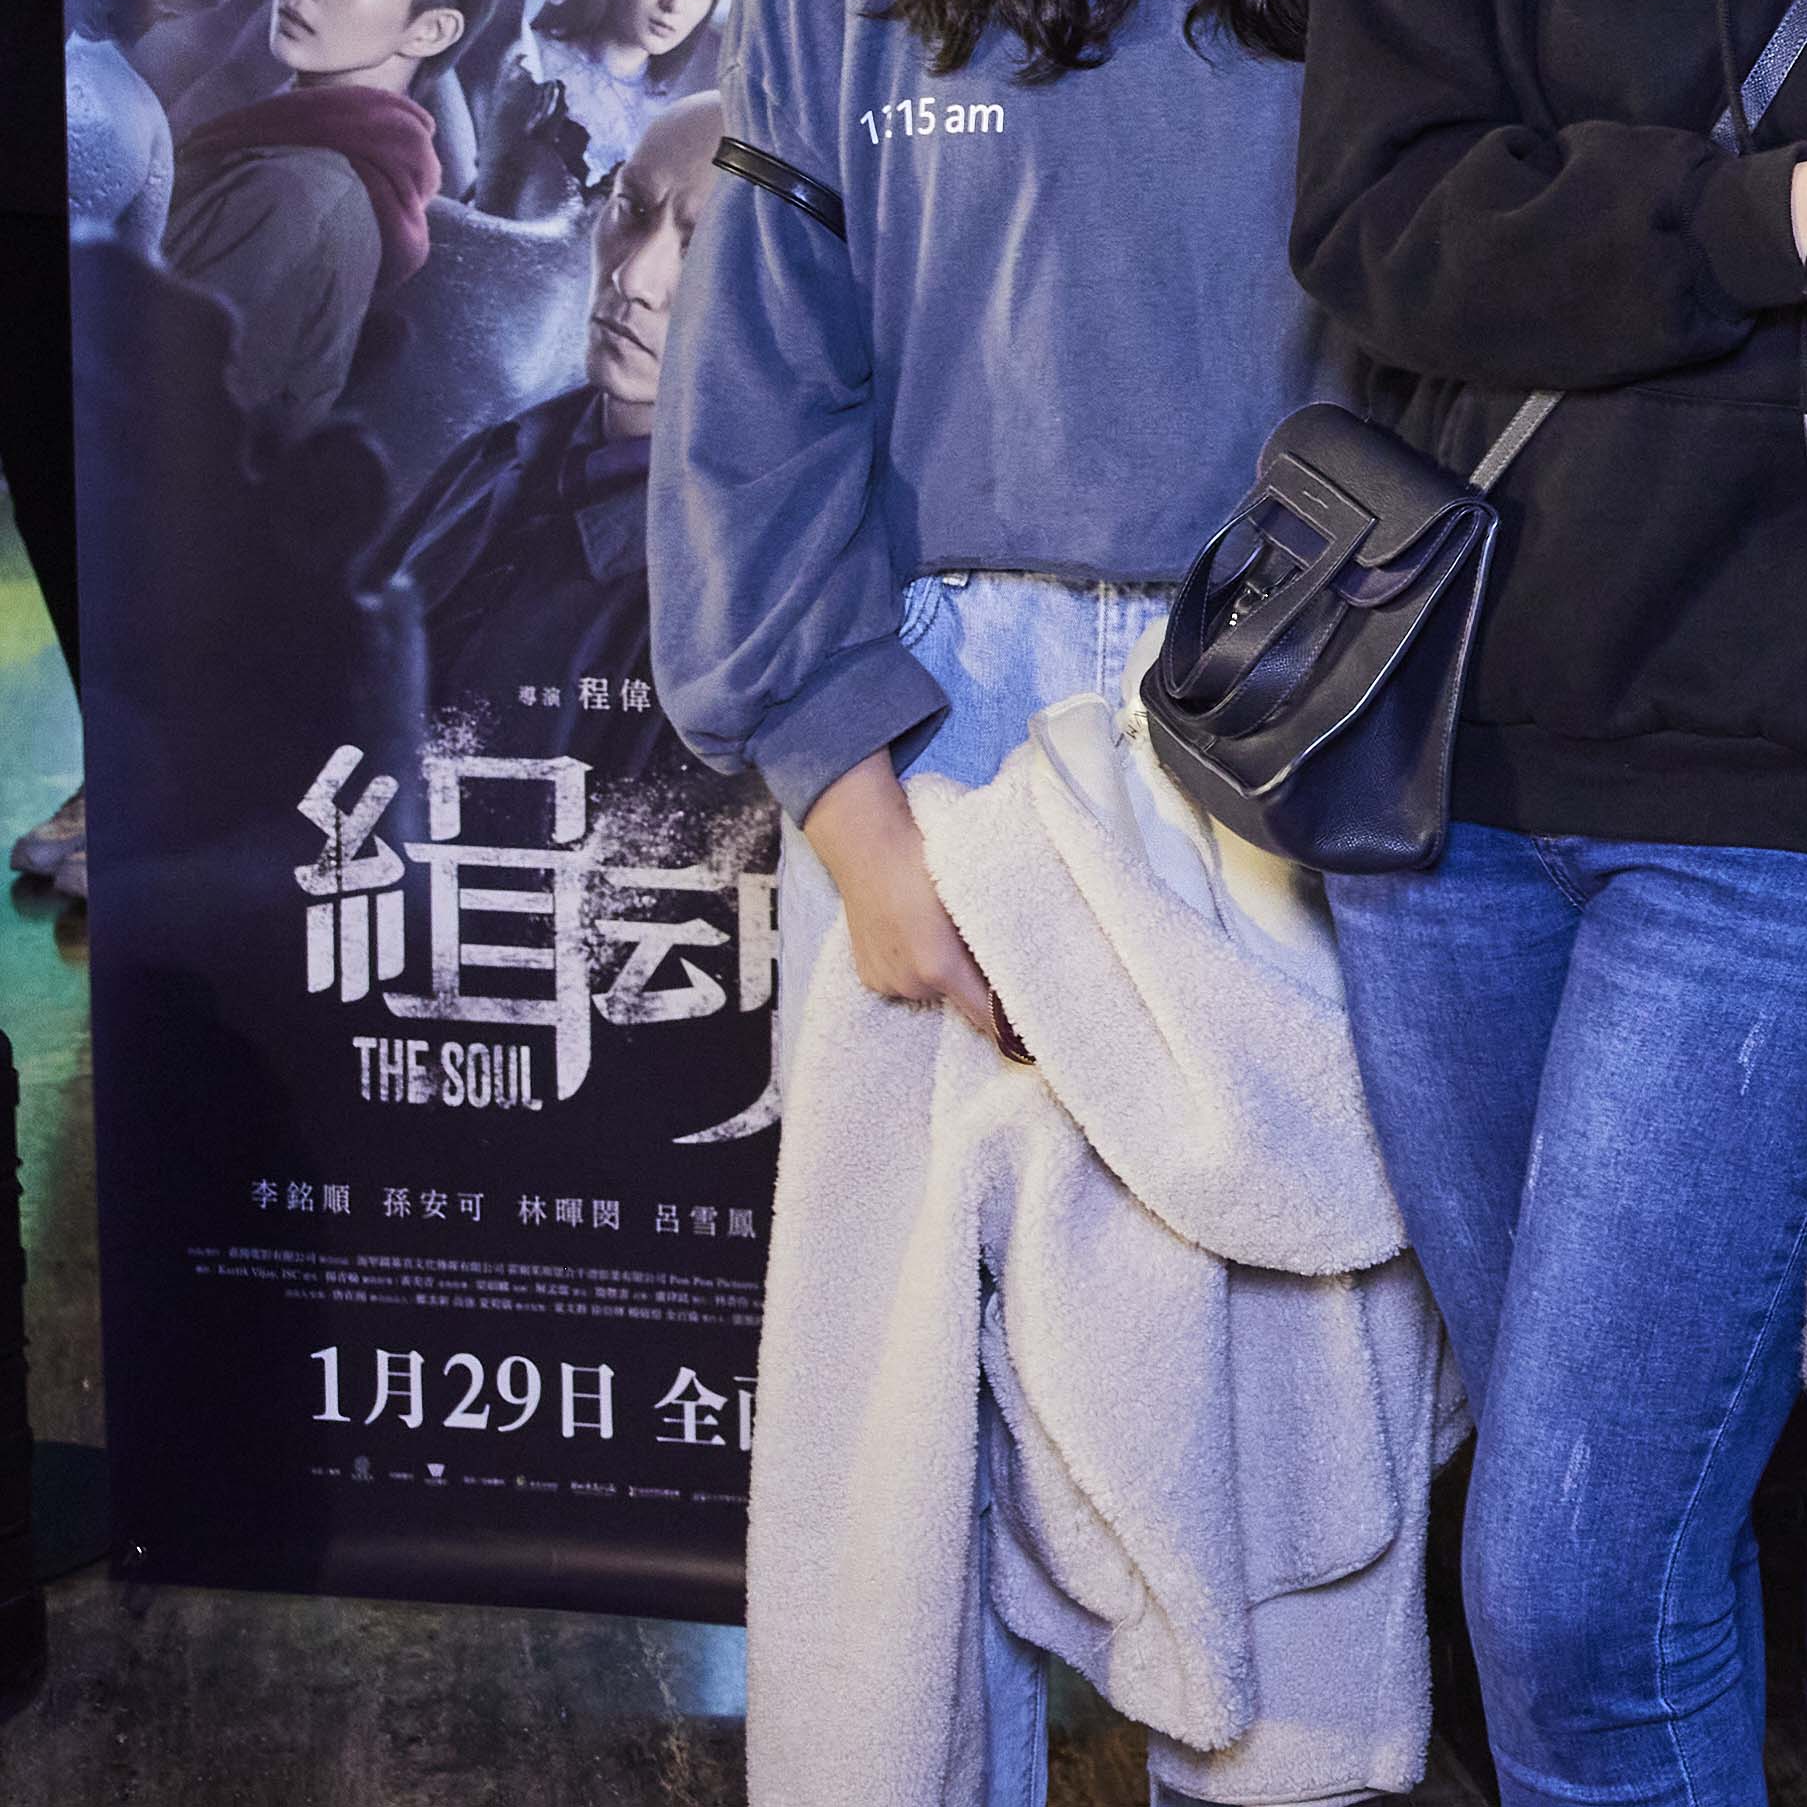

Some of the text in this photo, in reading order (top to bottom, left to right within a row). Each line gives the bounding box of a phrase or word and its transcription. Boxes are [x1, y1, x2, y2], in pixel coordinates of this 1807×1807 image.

[352, 1036, 543, 1112] THE SOUL
[382, 1188, 485, 1223] 孫安可
[653, 1203, 757, 1239] 呂雪鳳
[310, 1345, 616, 1440] 1月29日
